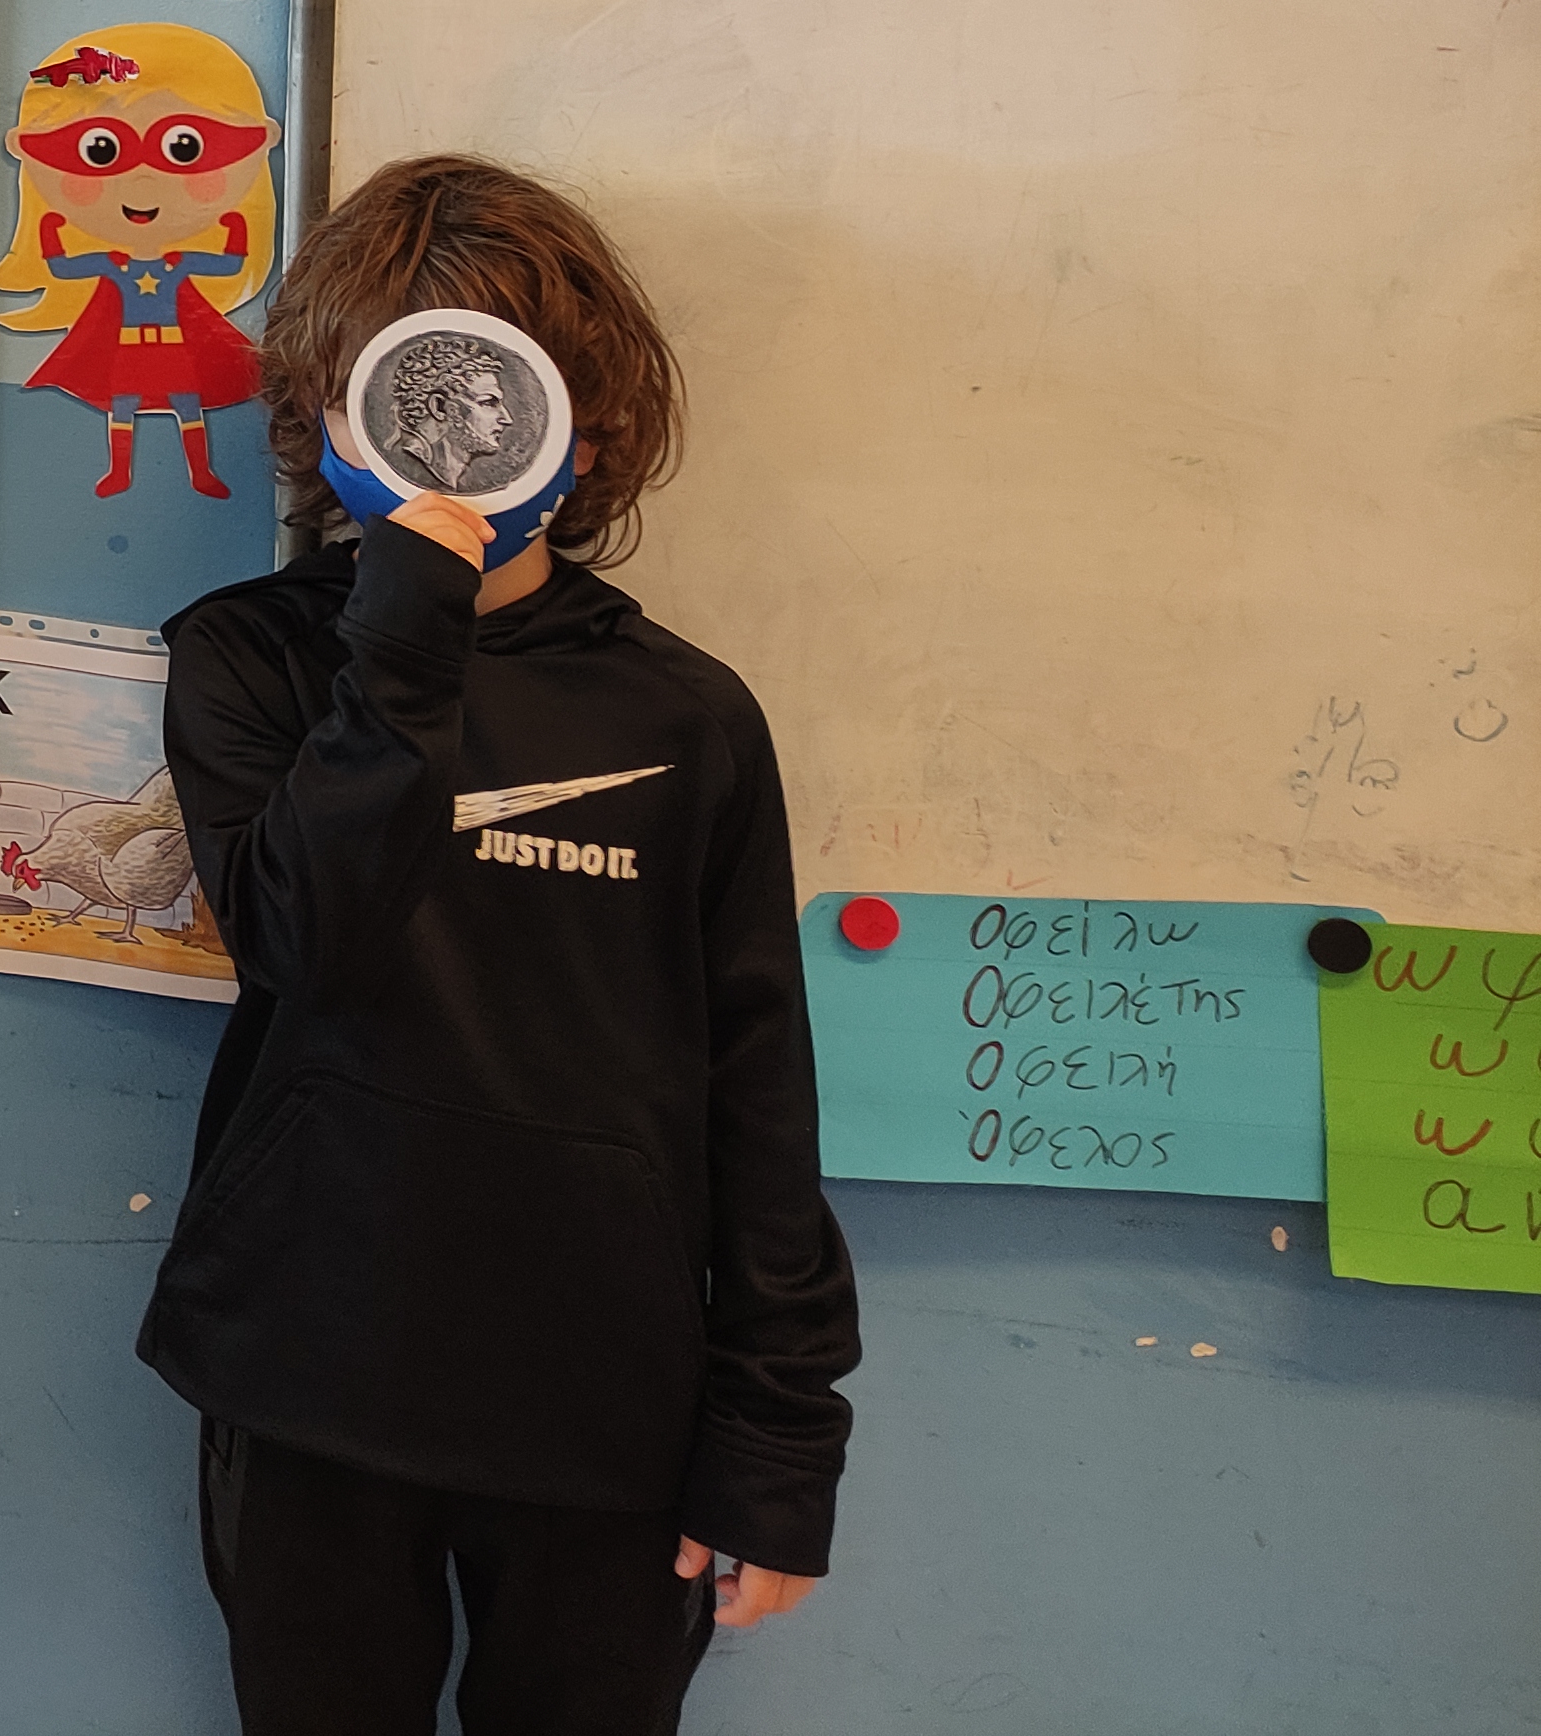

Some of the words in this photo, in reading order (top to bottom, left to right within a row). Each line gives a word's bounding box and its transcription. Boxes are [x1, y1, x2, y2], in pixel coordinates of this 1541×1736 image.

[475, 828, 555, 870] JUST
[557, 840, 605, 876] DO
[607, 846, 639, 880] IT.
